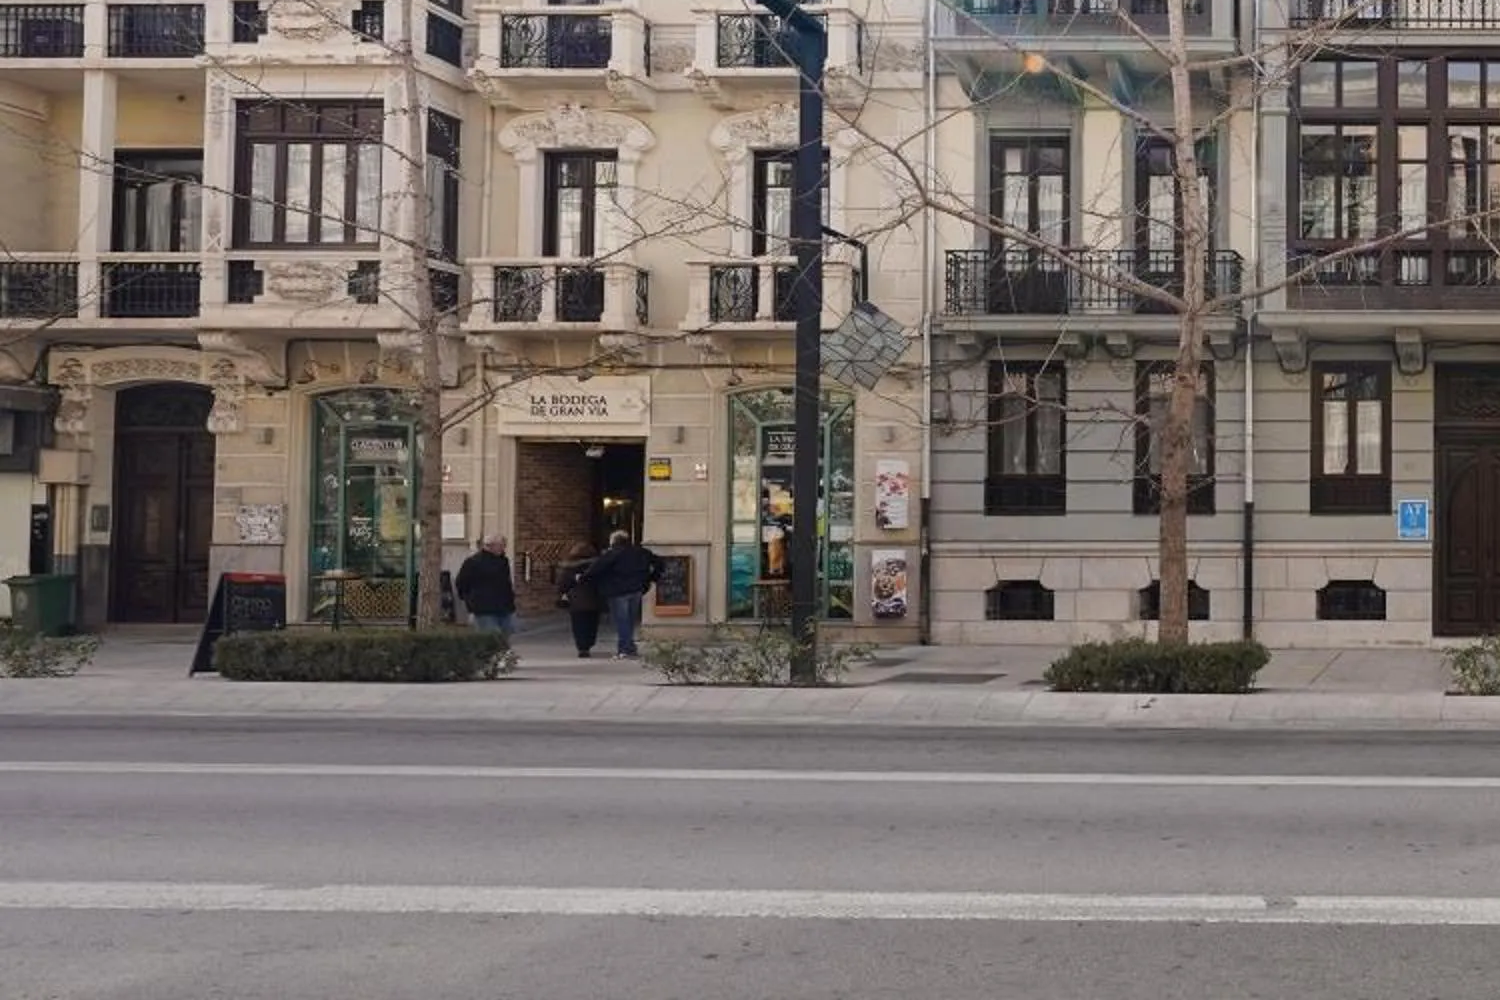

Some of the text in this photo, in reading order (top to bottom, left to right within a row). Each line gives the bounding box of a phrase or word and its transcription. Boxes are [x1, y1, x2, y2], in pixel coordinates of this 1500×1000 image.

[530, 395, 607, 405] LA BODEGA
[530, 405, 546, 416] DE
[549, 405, 584, 416] GRAN
